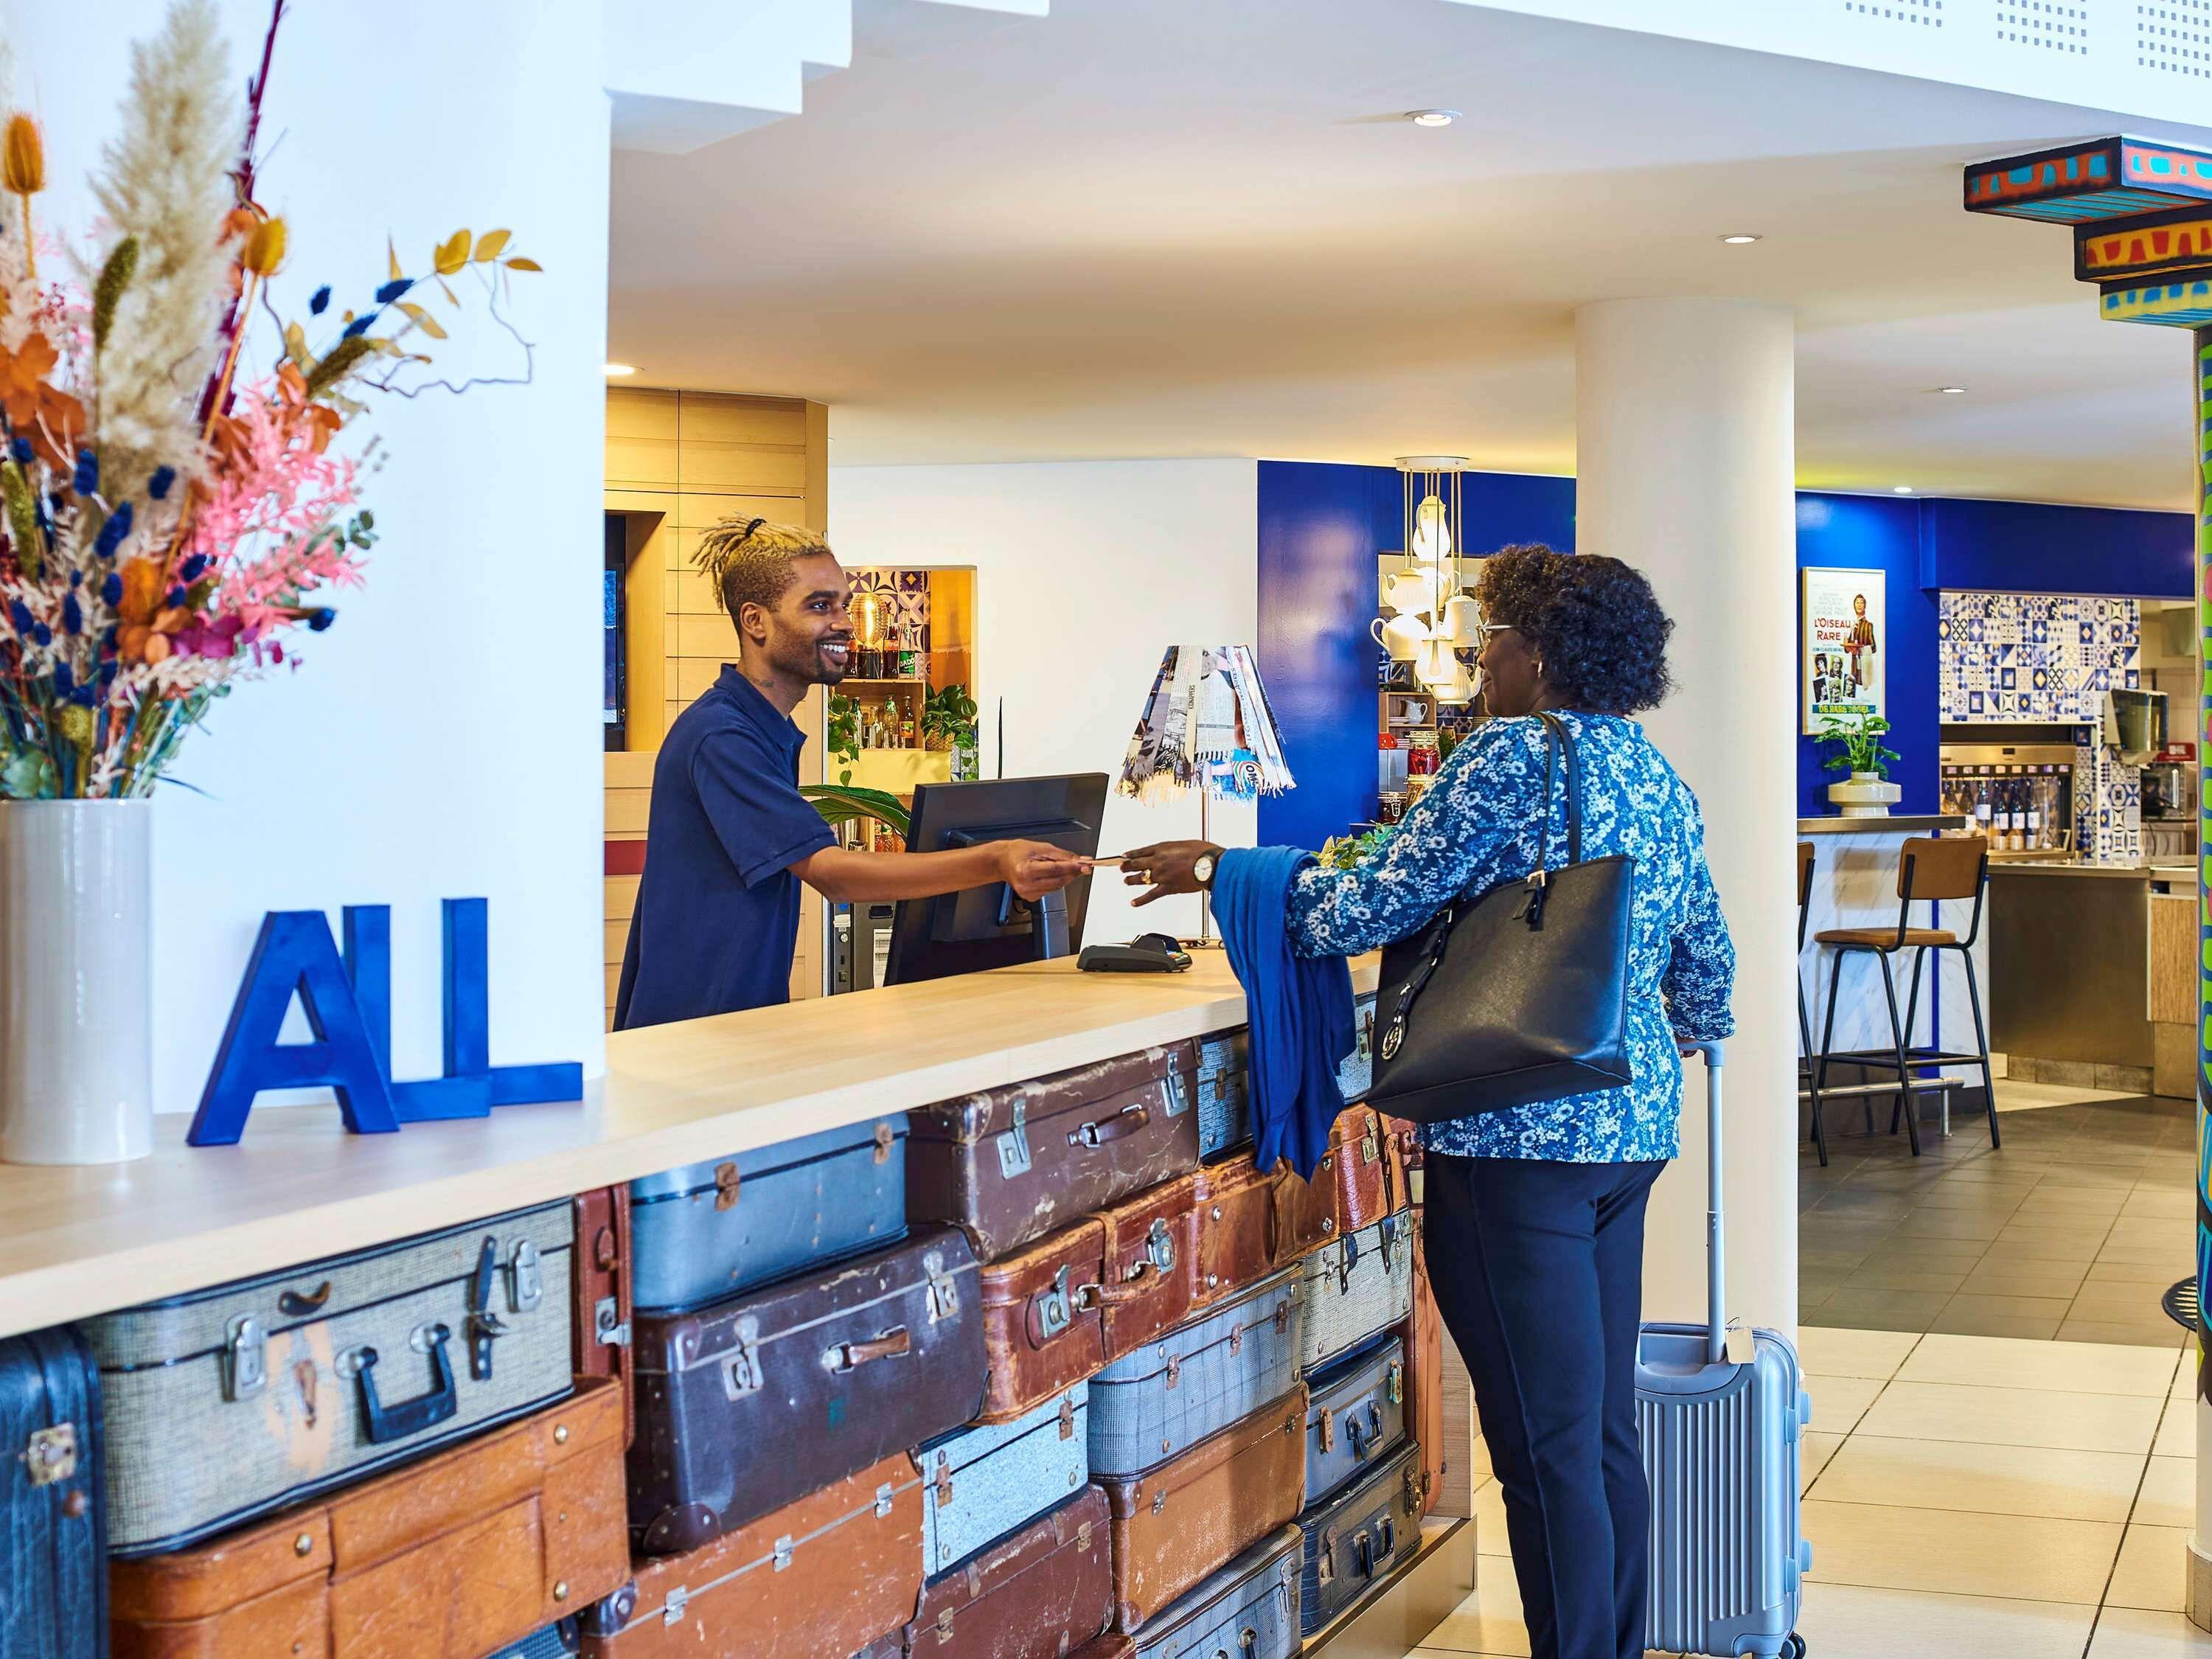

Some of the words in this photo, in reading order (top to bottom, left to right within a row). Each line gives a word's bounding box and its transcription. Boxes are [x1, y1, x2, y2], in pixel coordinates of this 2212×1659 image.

[1815, 618, 1851, 627] L'OISEAU
[1817, 630, 1841, 640] RARE
[187, 897, 582, 1147] ALL
